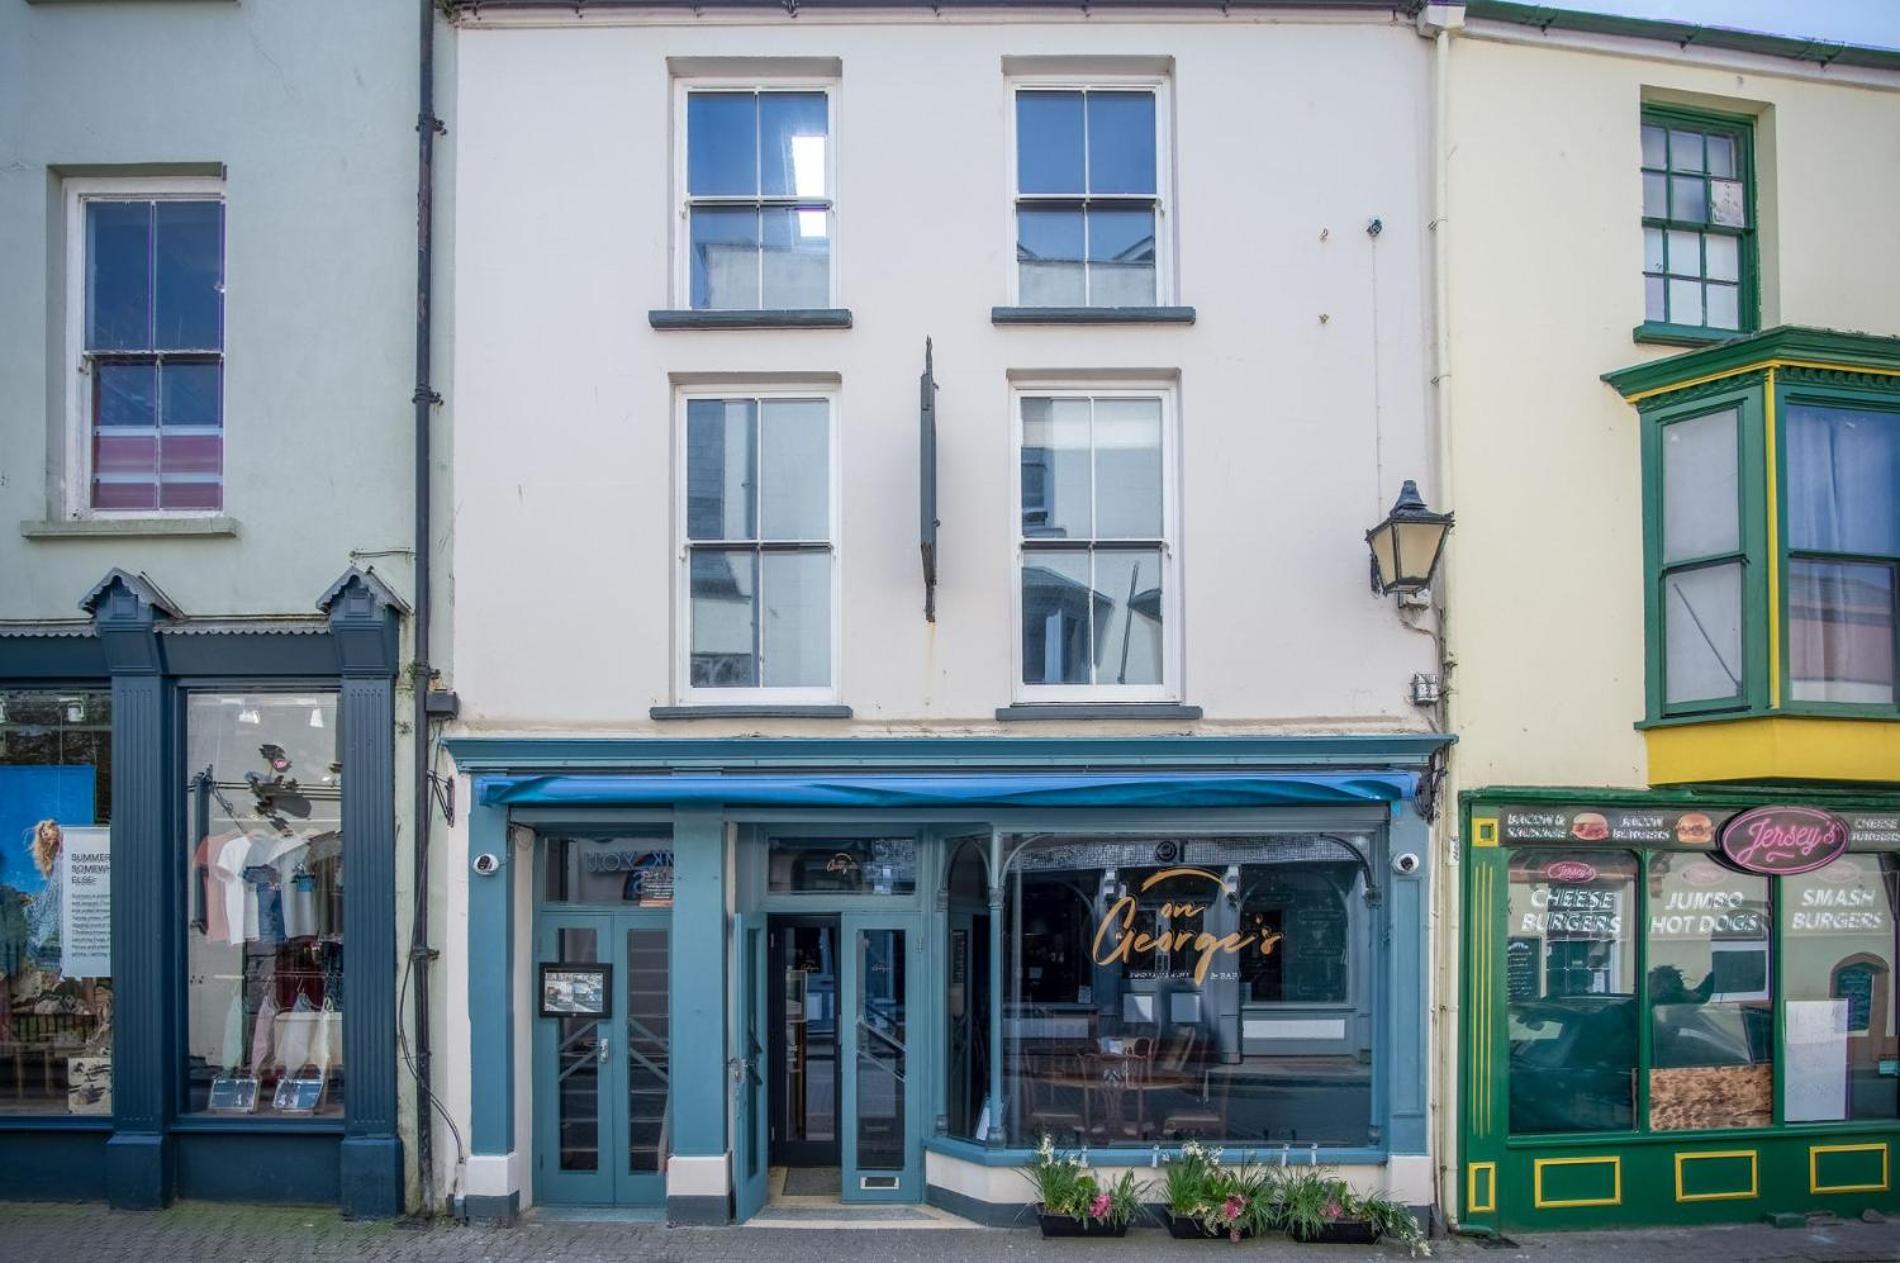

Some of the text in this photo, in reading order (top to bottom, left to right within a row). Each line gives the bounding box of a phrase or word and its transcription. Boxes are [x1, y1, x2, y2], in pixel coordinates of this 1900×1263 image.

[1736, 818, 1836, 864] Jersey's
[1531, 890, 1616, 908] CHEESE
[1664, 891, 1744, 911] JUMBO
[1801, 889, 1876, 907] SMASH
[1160, 902, 1206, 918] on
[1521, 912, 1623, 933] BURGERS
[1650, 914, 1758, 934] HOT DOGS
[1791, 912, 1882, 929] BURGERS
[1093, 896, 1284, 987] George's
